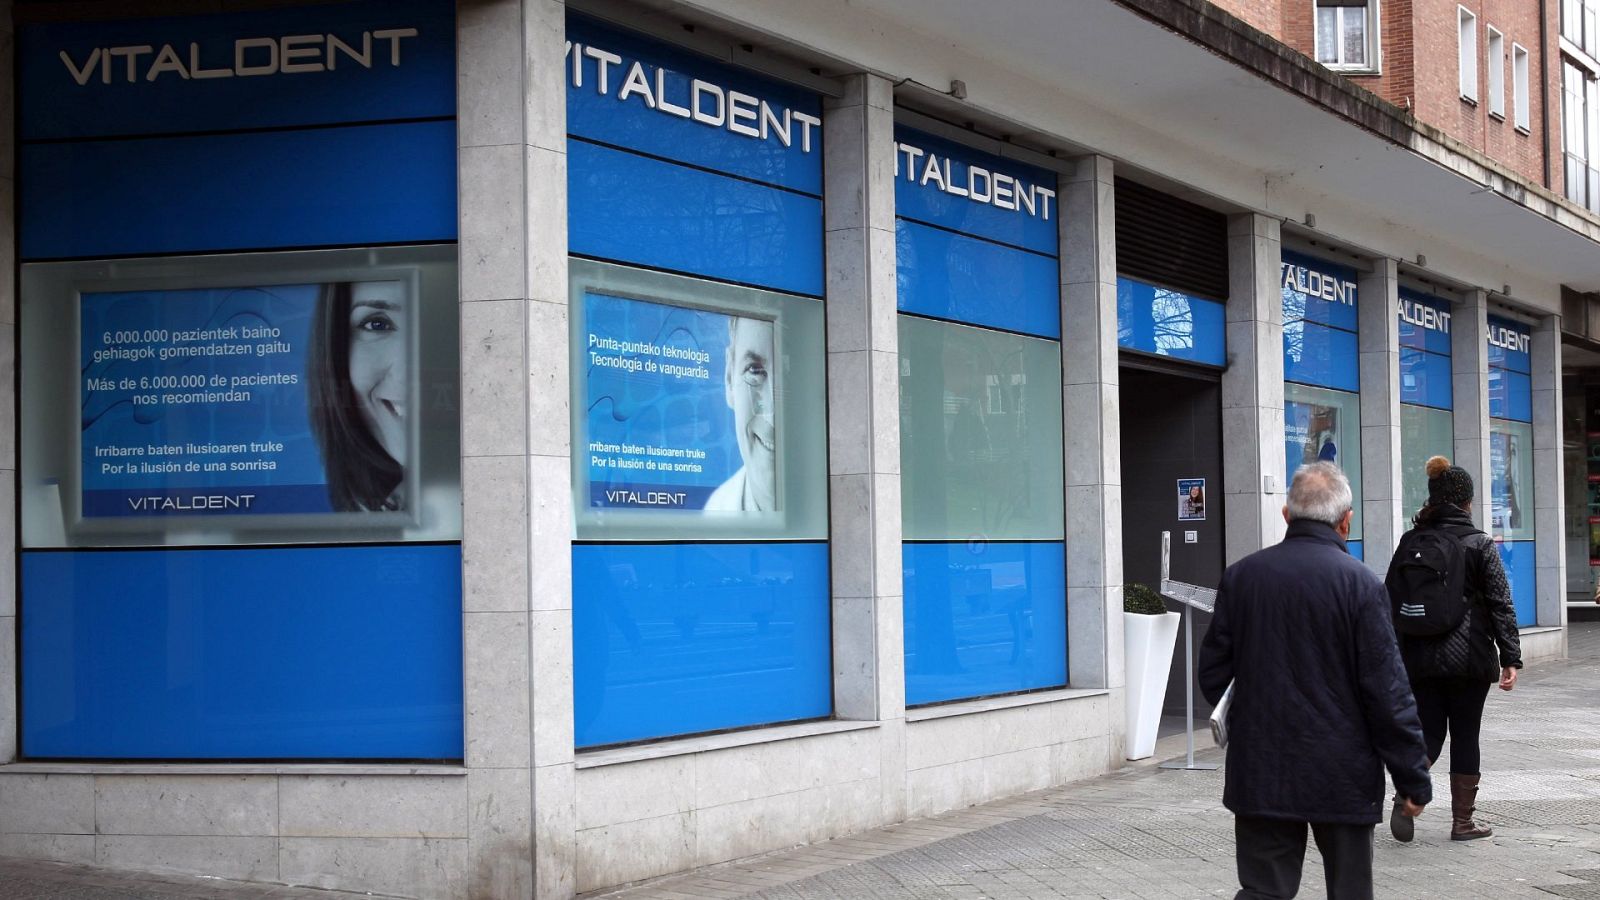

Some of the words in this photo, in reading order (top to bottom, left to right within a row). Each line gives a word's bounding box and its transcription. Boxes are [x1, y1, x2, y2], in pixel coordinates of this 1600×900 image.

[59, 28, 418, 86] VITALDENT
[565, 40, 822, 153] ITALDENT
[103, 329, 168, 345] 6.000.000
[172, 327, 238, 343] pazientek
[242, 325, 281, 339] baino
[93, 345, 155, 363] gehiagok
[159, 343, 252, 360] gomendatzen
[256, 341, 291, 357] gaitu
[589, 333, 660, 356] Punta-puntako
[662, 344, 710, 364] teknologia
[589, 351, 643, 373] Tecnología
[644, 359, 657, 373] de
[660, 363, 709, 379] vanguardia
[87, 377, 116, 391] Más
[119, 377, 136, 390] de
[140, 374, 206, 389] 6.000.000
[209, 374, 227, 387] de
[231, 372, 298, 389] pacientes
[133, 393, 158, 405] nos
[162, 389, 251, 404] recomiendan
[95, 444, 145, 457] Irribarre
[148, 444, 183, 456] baten
[186, 442, 247, 455] ilusioaren
[250, 441, 284, 453] truke
[622, 443, 645, 455] baten
[646, 445, 684, 458] ilusioaren
[685, 448, 706, 459] truke
[102, 463, 123, 475] Por
[126, 462, 138, 474] la
[141, 461, 181, 474] ilusión
[184, 460, 200, 472] de
[203, 461, 227, 472] una
[230, 458, 277, 471] sonrisa
[591, 456, 606, 467] Por
[608, 457, 616, 468] la
[617, 458, 644, 470] ilusión
[645, 459, 656, 470] de
[658, 462, 673, 471] una
[674, 462, 702, 473] sonrisa
[128, 494, 256, 511] VITALDENT
[605, 489, 687, 505] VITALDENT
